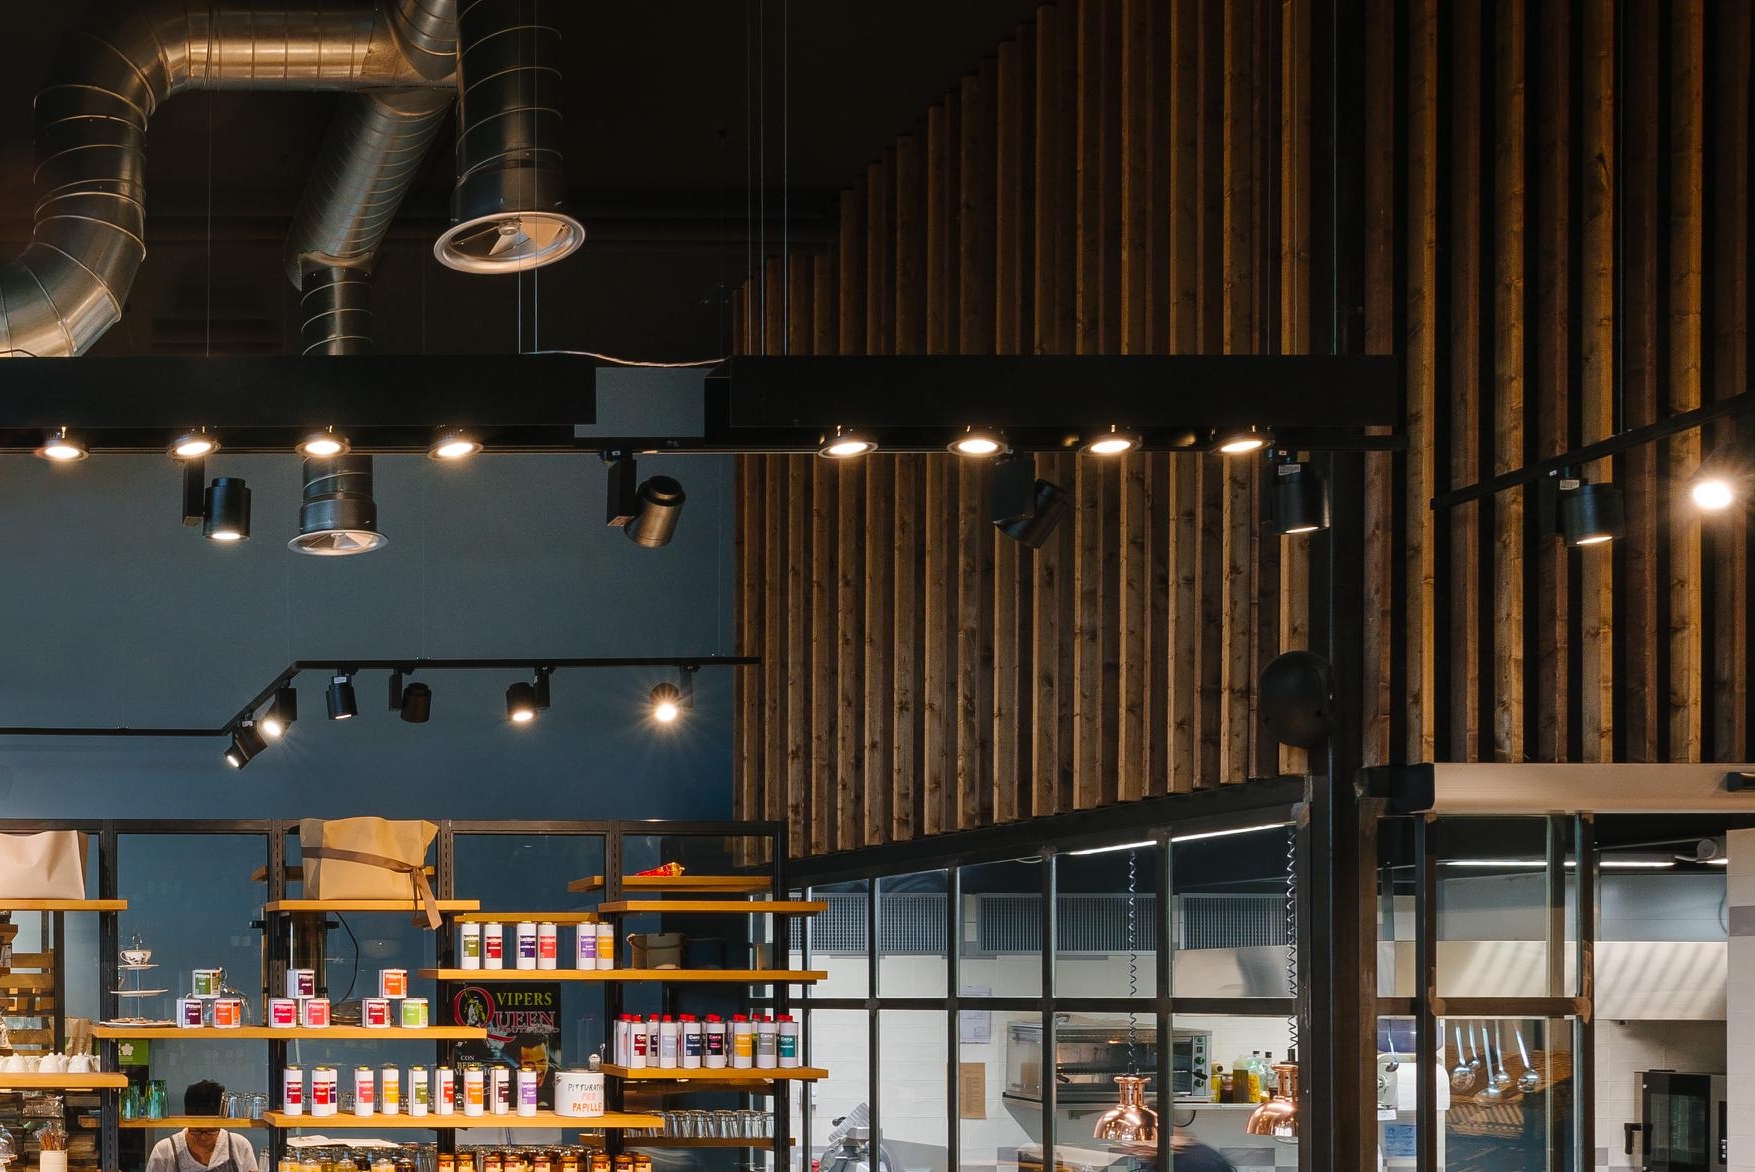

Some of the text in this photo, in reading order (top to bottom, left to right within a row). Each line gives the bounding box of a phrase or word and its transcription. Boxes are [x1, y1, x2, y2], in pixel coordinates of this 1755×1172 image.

[496, 992, 552, 1006] VIPERS
[453, 986, 557, 1029] QUEEN
[572, 1102, 602, 1112] PAPILLE
